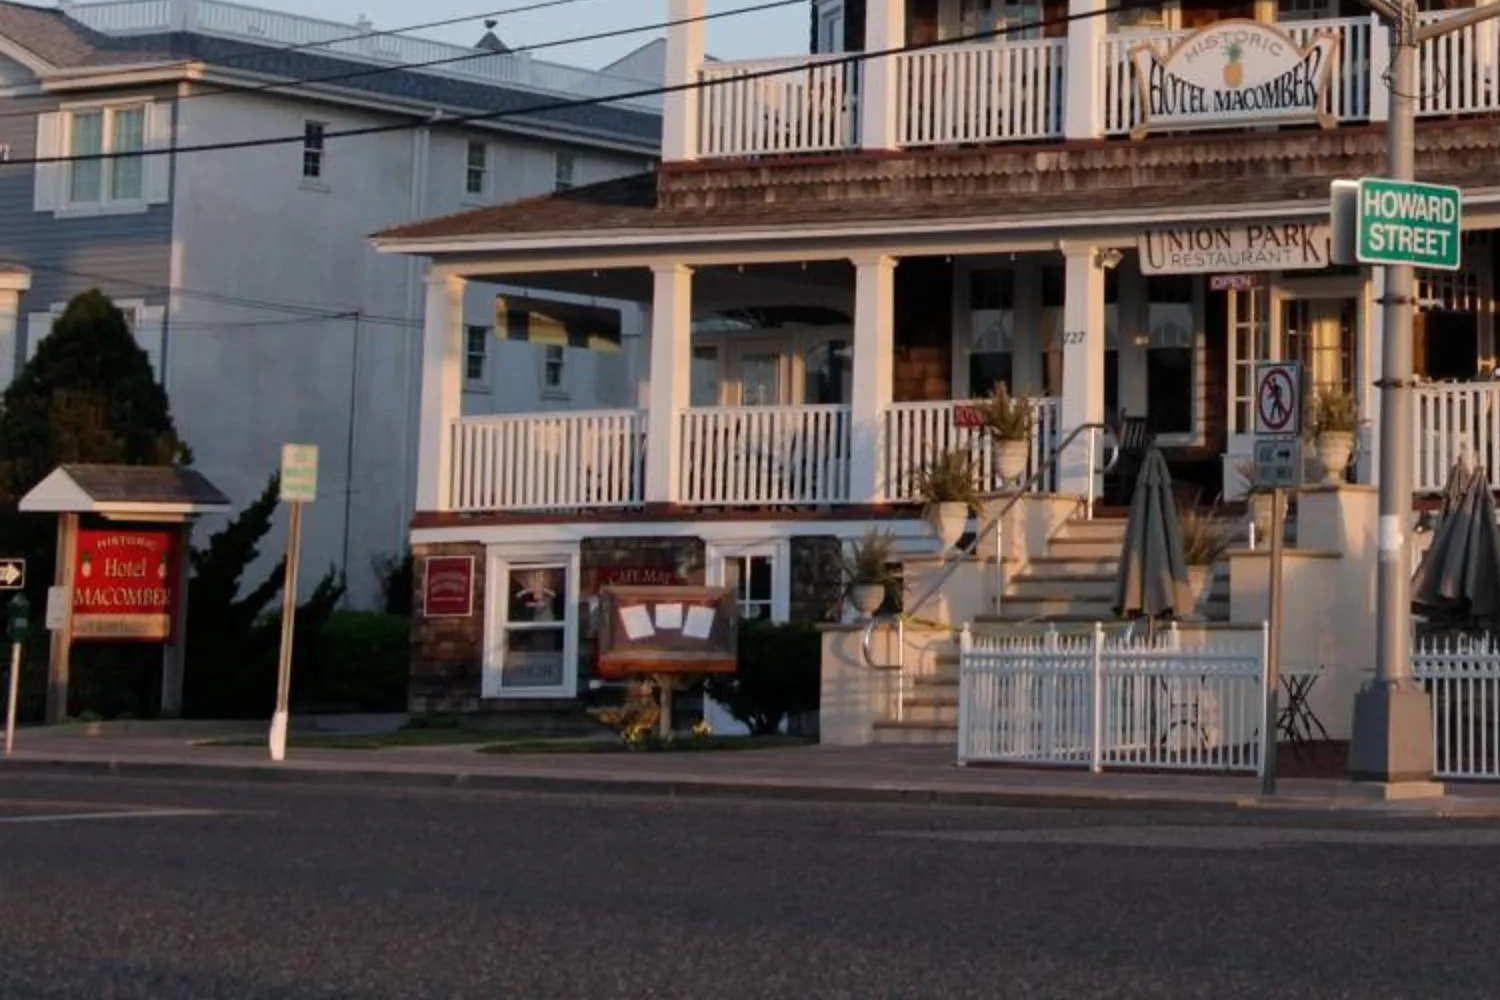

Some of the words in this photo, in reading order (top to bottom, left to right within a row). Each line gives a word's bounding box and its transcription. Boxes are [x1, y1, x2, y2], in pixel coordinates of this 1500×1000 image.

[1184, 30, 1284, 63] HISTORIC
[1149, 57, 1209, 115] HOTEL
[1213, 46, 1322, 113] MACOMBER
[1364, 189, 1456, 224] HOWARD
[1143, 225, 1232, 269] UNION
[1247, 223, 1321, 262] PARK
[1368, 222, 1452, 257] STREET
[1171, 249, 1293, 267] RESTAURANT
[105, 558, 147, 578] Hotel
